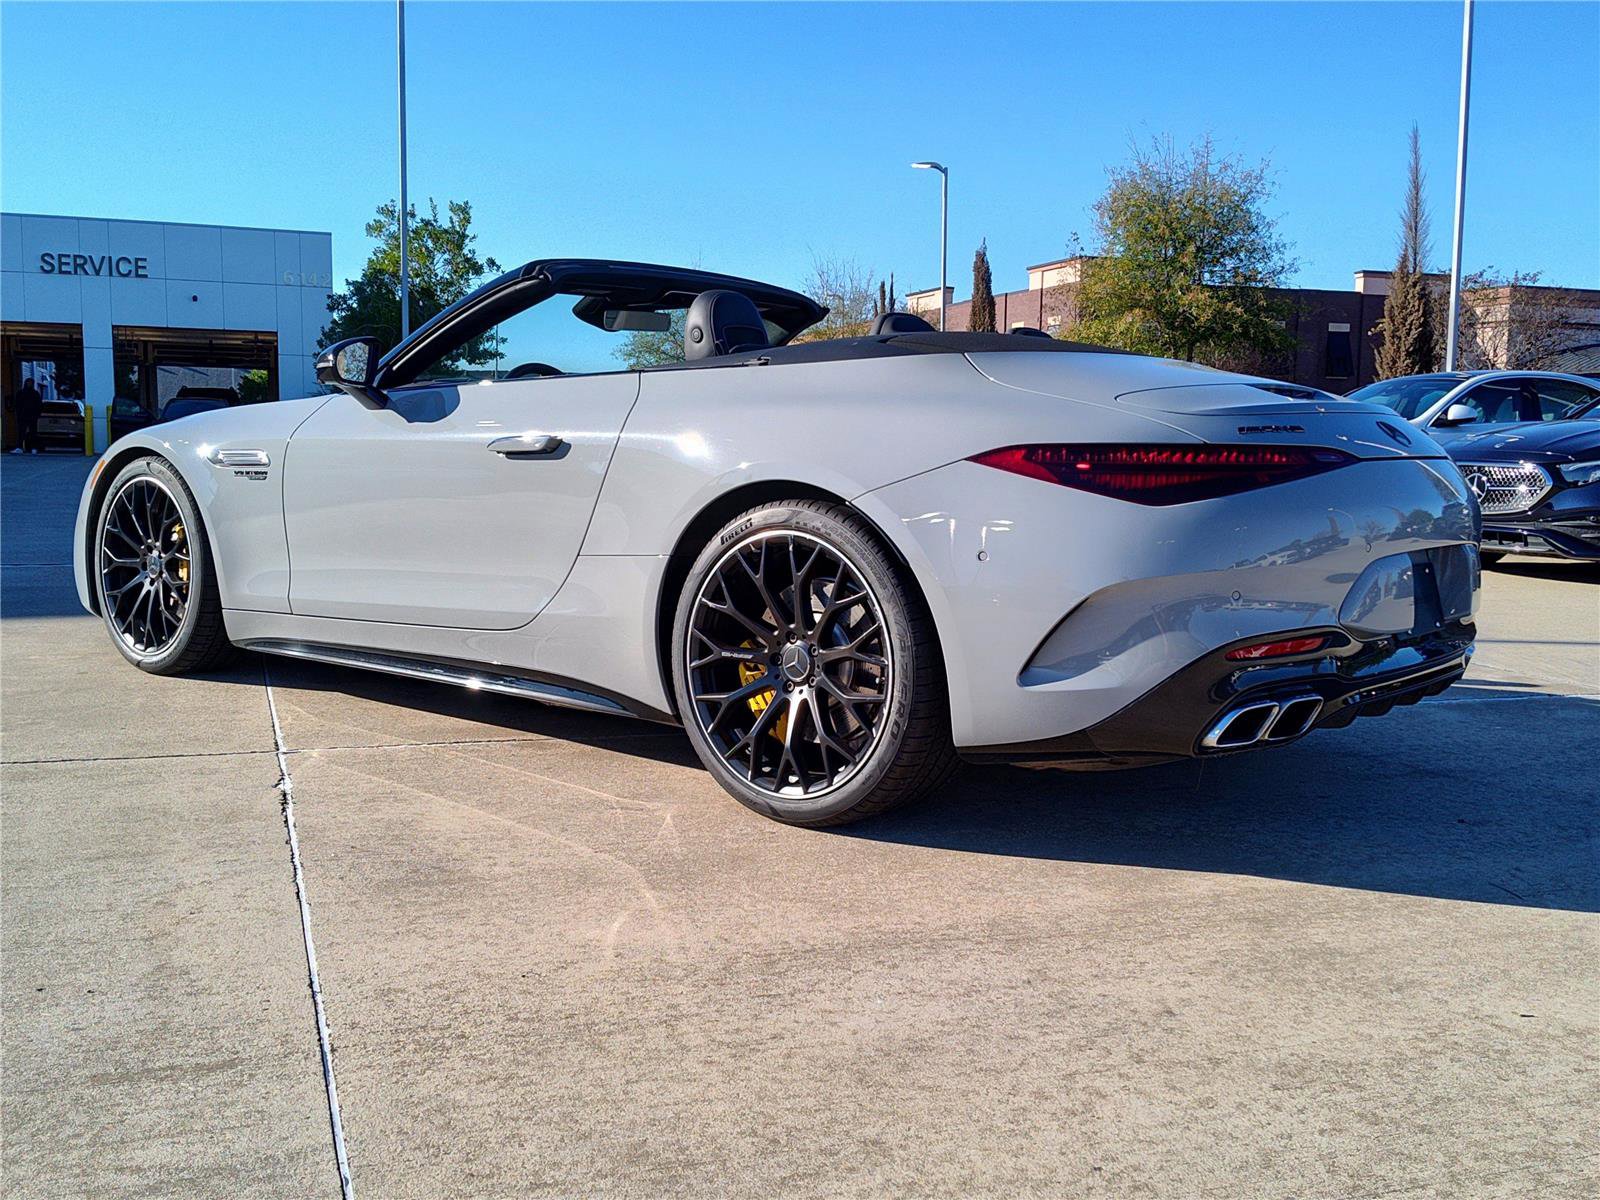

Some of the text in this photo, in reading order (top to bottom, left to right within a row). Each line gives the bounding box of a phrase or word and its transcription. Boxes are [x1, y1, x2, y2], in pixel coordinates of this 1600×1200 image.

[40, 252, 148, 278] SERVICE
[283, 270, 331, 288] 6142
[719, 517, 753, 546] PIRELLI
